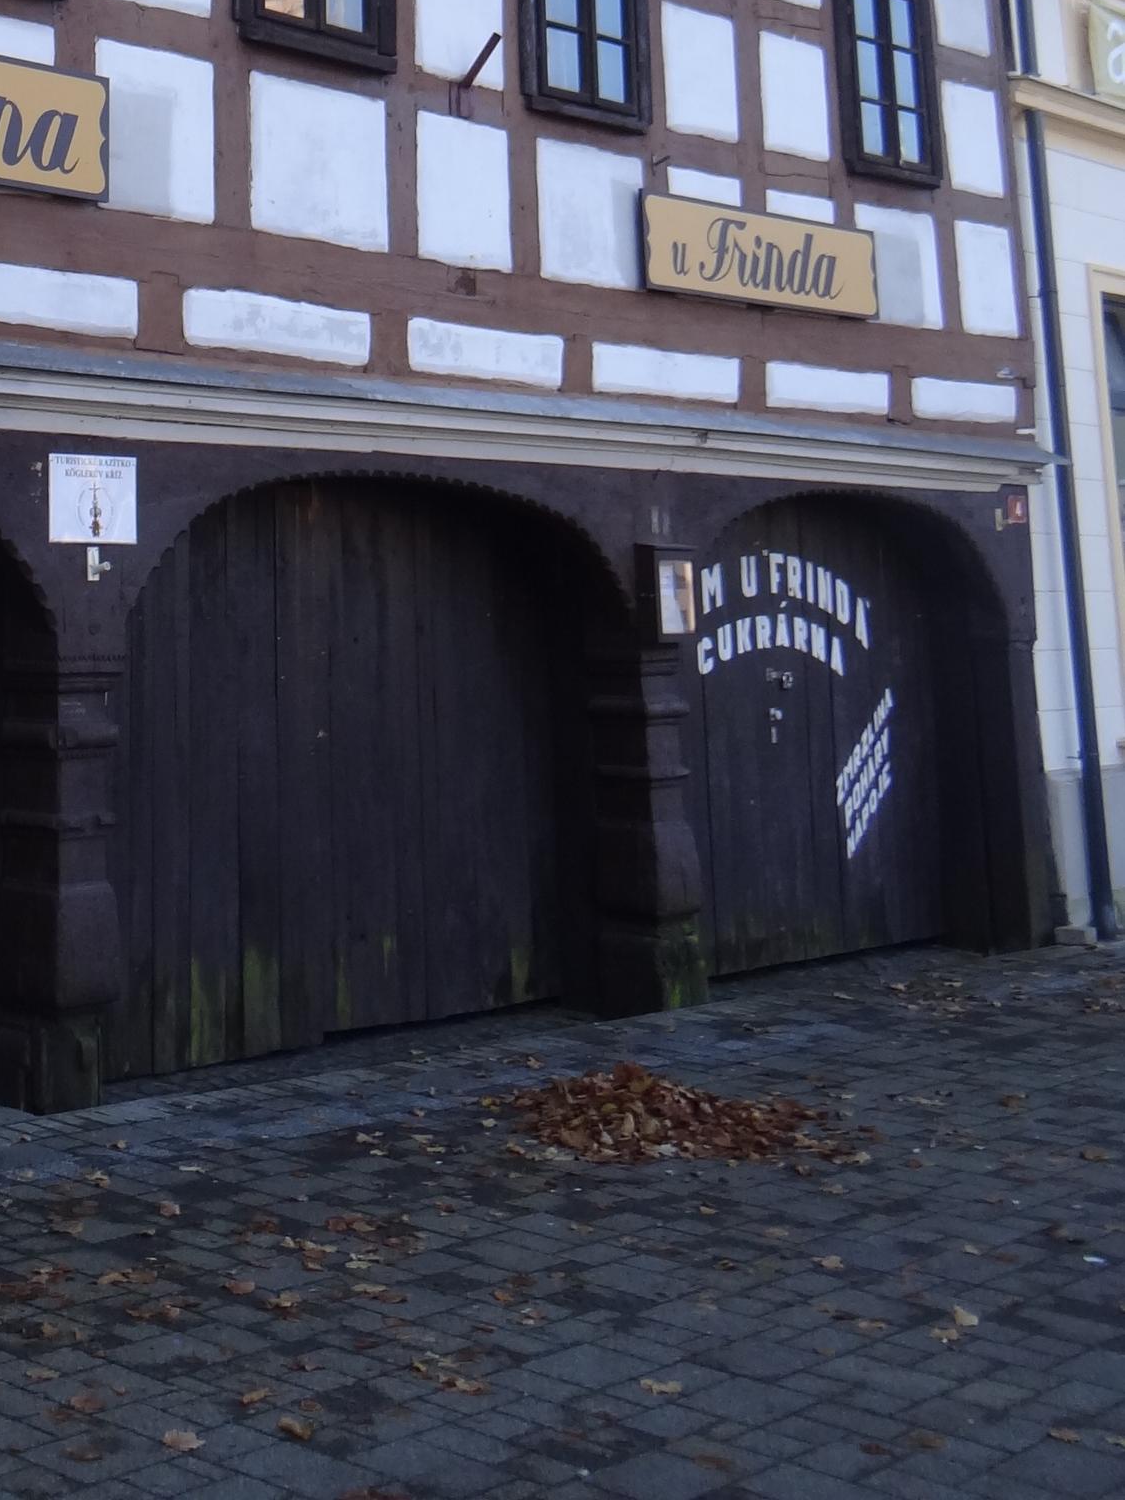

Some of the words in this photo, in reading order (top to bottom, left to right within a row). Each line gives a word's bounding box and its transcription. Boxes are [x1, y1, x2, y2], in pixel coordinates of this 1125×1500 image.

[672, 241, 690, 277] u
[699, 217, 844, 300] Frinda
[697, 601, 844, 676] CUKRÁRNA
[836, 688, 893, 806] ZMRZLINA
